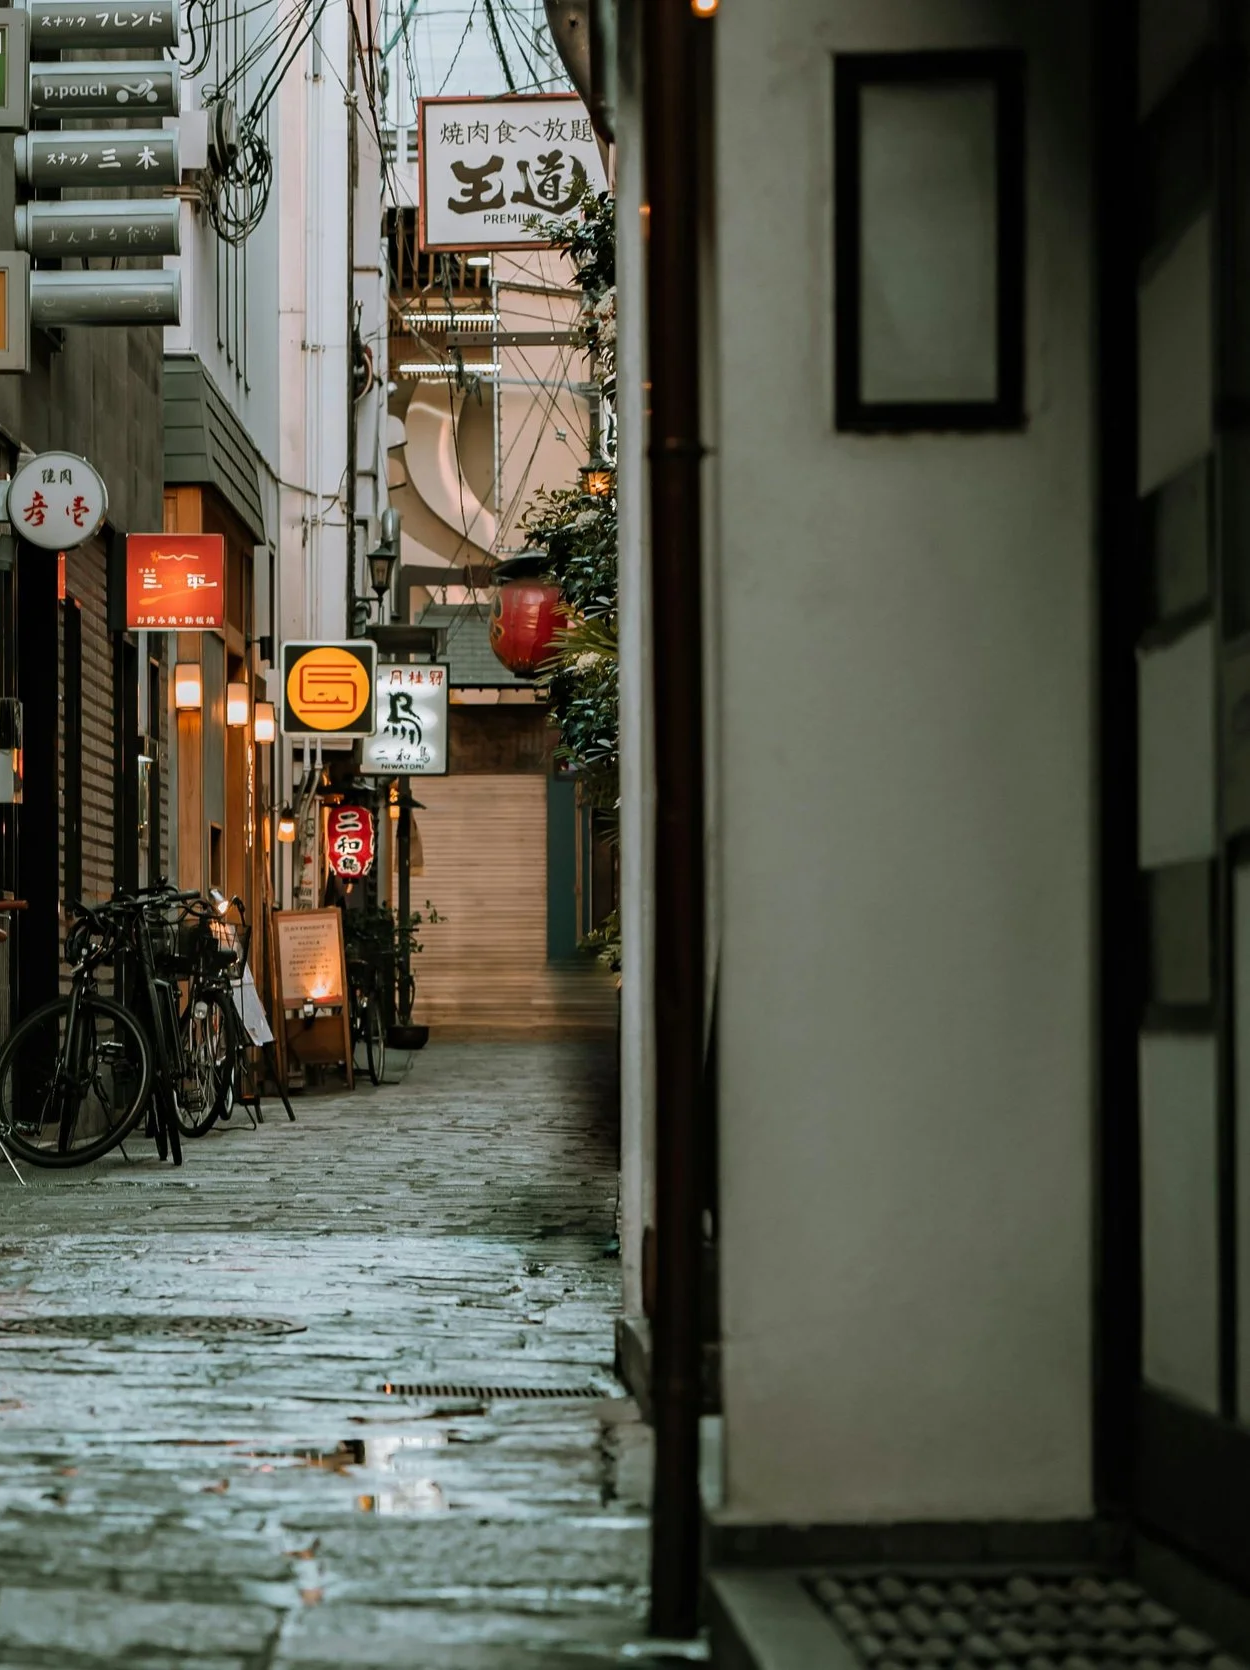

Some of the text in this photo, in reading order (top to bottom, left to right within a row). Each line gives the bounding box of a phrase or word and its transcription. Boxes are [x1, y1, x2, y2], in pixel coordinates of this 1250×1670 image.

[41, 11, 163, 27] スナック フレンド
[44, 81, 108, 100] p.pouch
[439, 115, 594, 146] 焼肉食べ放題
[46, 145, 160, 170] スナック 三木
[447, 149, 588, 216] 王道
